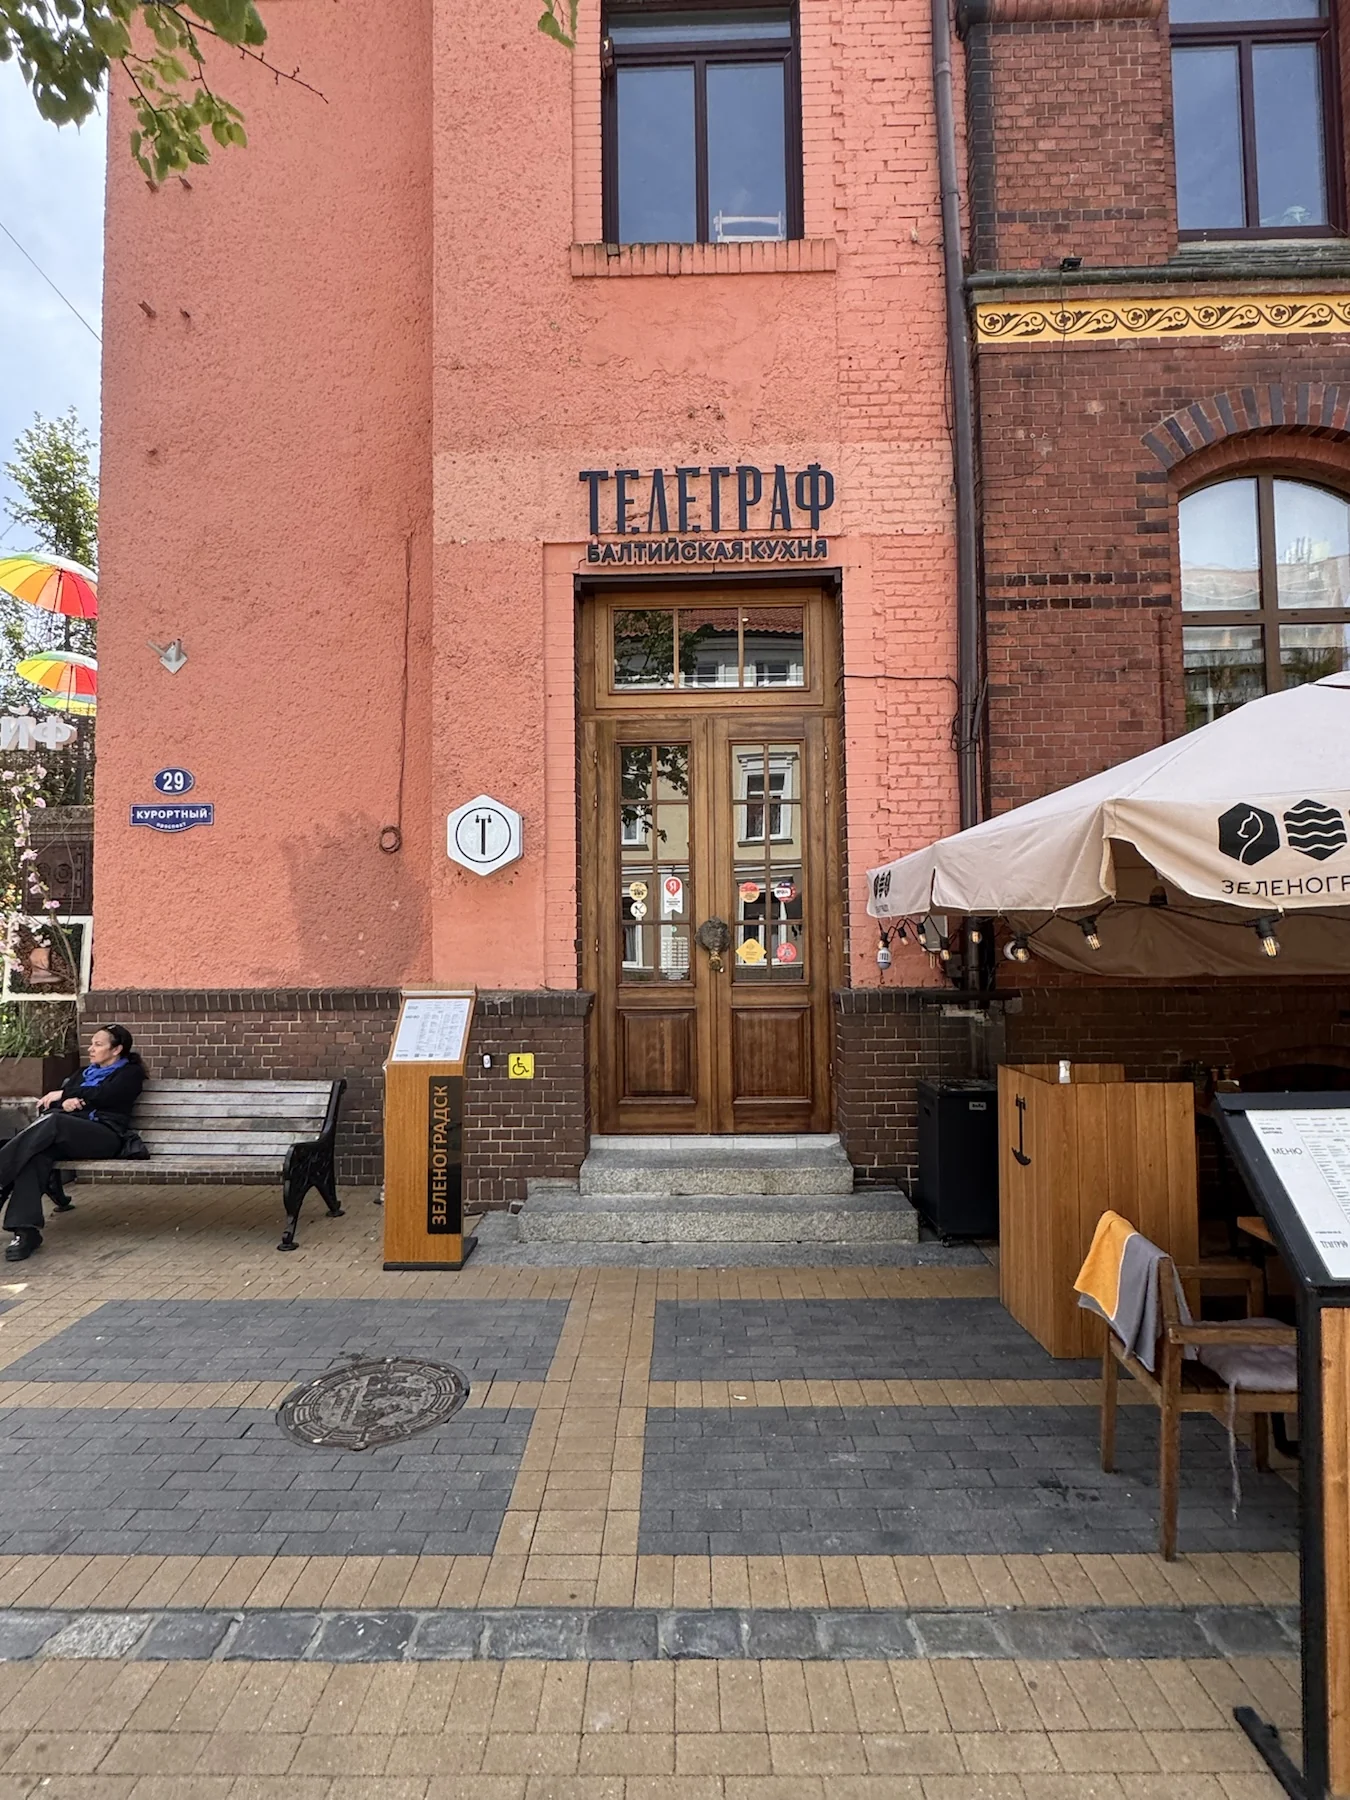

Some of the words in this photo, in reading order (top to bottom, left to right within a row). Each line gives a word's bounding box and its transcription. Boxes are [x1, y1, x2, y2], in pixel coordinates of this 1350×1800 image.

[579, 462, 834, 535] ТЕЛЕГРАФ
[587, 538, 743, 563] БАЛТИЙСКАЯ
[751, 539, 828, 559] КУХНЯ
[162, 771, 184, 791] 29
[136, 808, 208, 819] КУРОРТНЫЙ
[431, 1084, 448, 1226] ЗЕЛЕНОГРАДСК
[1271, 1147, 1303, 1156] МЕНЮ
